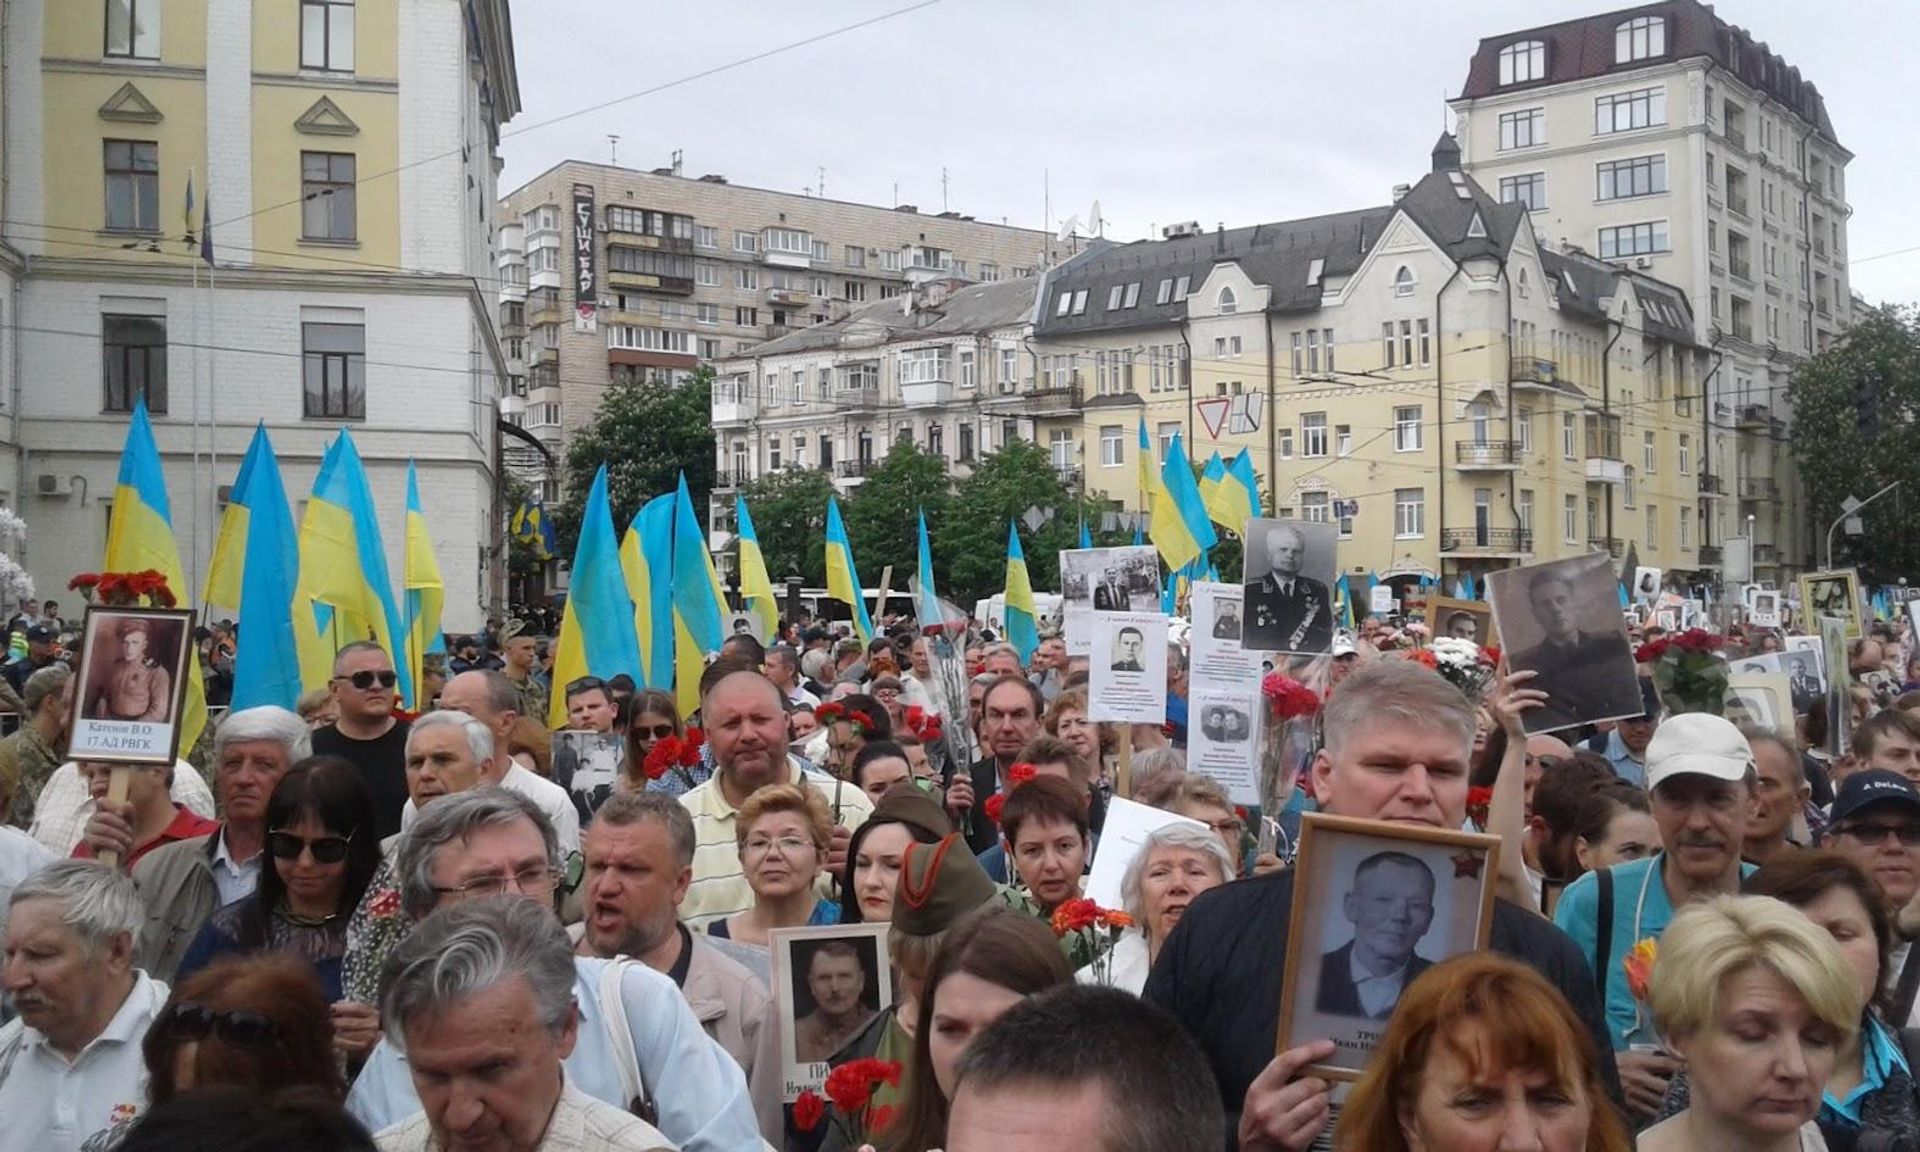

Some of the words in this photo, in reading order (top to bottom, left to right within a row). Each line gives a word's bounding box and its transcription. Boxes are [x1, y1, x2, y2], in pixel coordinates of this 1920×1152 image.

[576, 202, 592, 252] СУШИ
[579, 256, 593, 293] БАР
[87, 736, 98, 747] 17
[101, 737, 119, 749] АД
[121, 739, 152, 751] РВГК
